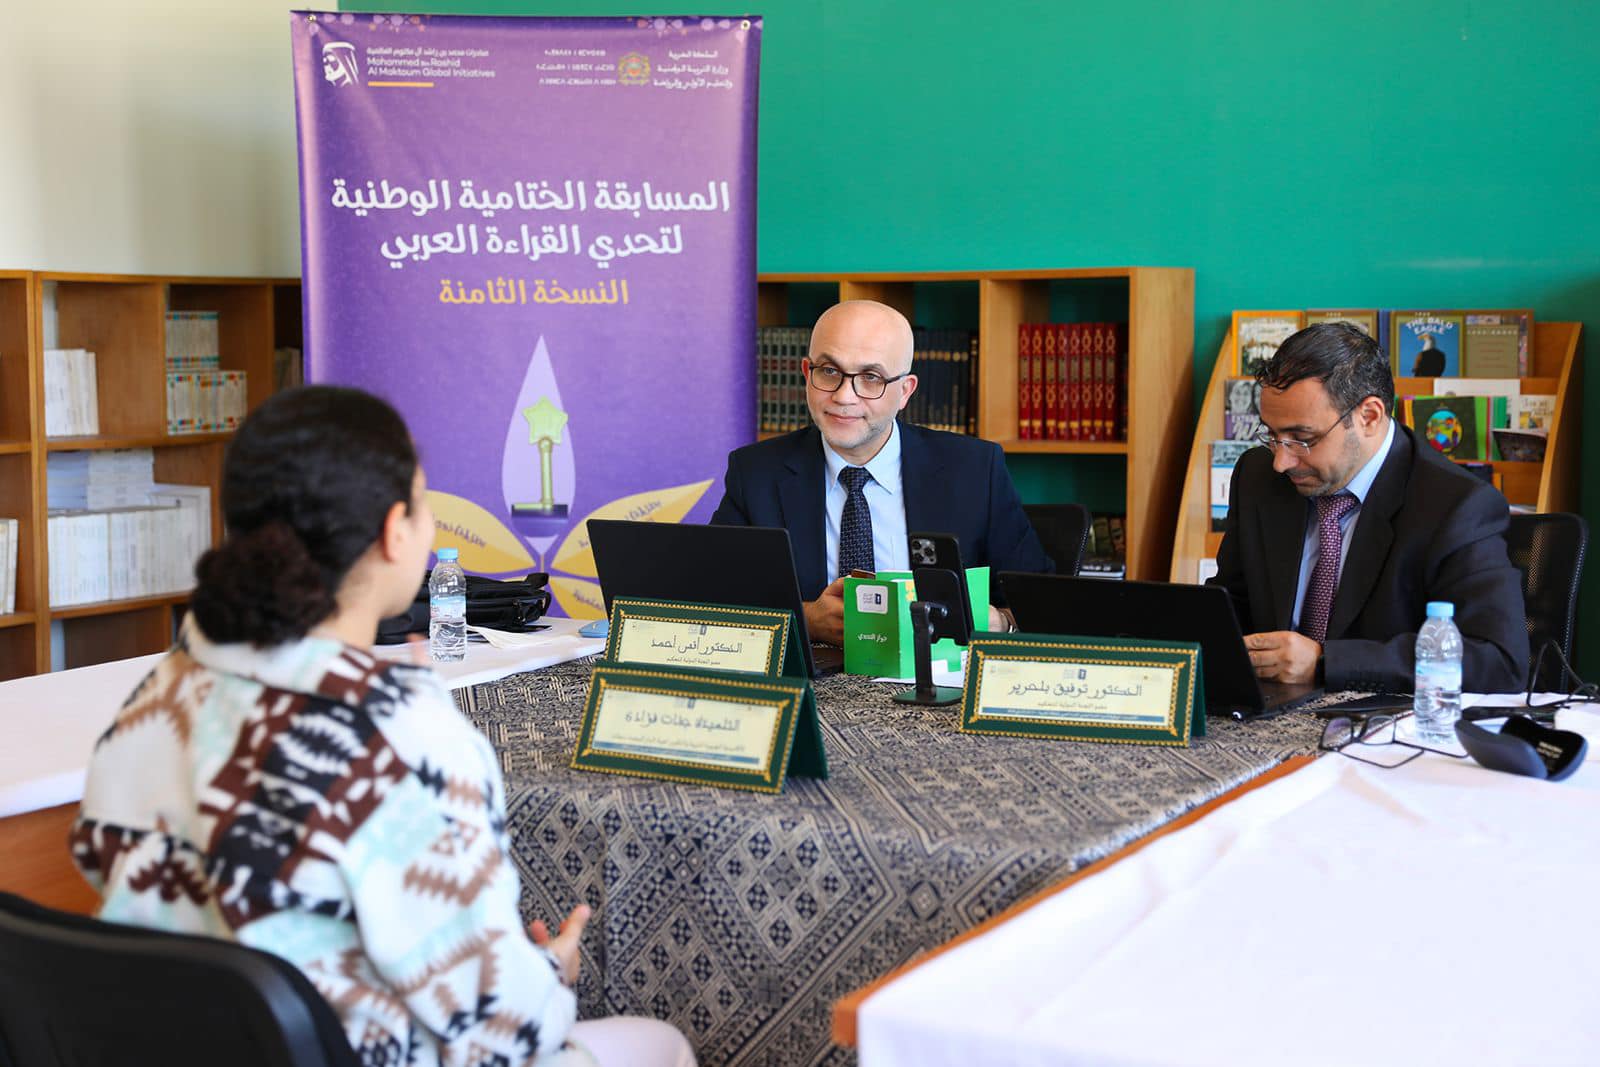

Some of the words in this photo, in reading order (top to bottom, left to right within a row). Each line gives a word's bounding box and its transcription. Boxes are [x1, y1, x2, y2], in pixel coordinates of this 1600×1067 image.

[367, 57, 420, 66] Mohammed
[431, 58, 460, 67] Rashid
[367, 66, 377, 75] Al
[379, 67, 421, 76] Maktoum
[422, 68, 451, 77] Global
[453, 69, 496, 78] Initiatives
[331, 179, 451, 216] الوطنية
[459, 180, 586, 217] الختامية
[594, 181, 730, 218] المسابقة
[380, 224, 478, 269] العربي
[486, 224, 581, 261] القراءة
[588, 224, 683, 269] لتحدي
[439, 276, 526, 305] الثامنة
[534, 279, 629, 305] النسخة
[651, 635, 676, 648] أحمد
[678, 637, 700, 653] أنس
[699, 642, 742, 655] الدكتور
[1053, 683, 1088, 697] توفيق
[1088, 684, 1142, 700] الدكتور
